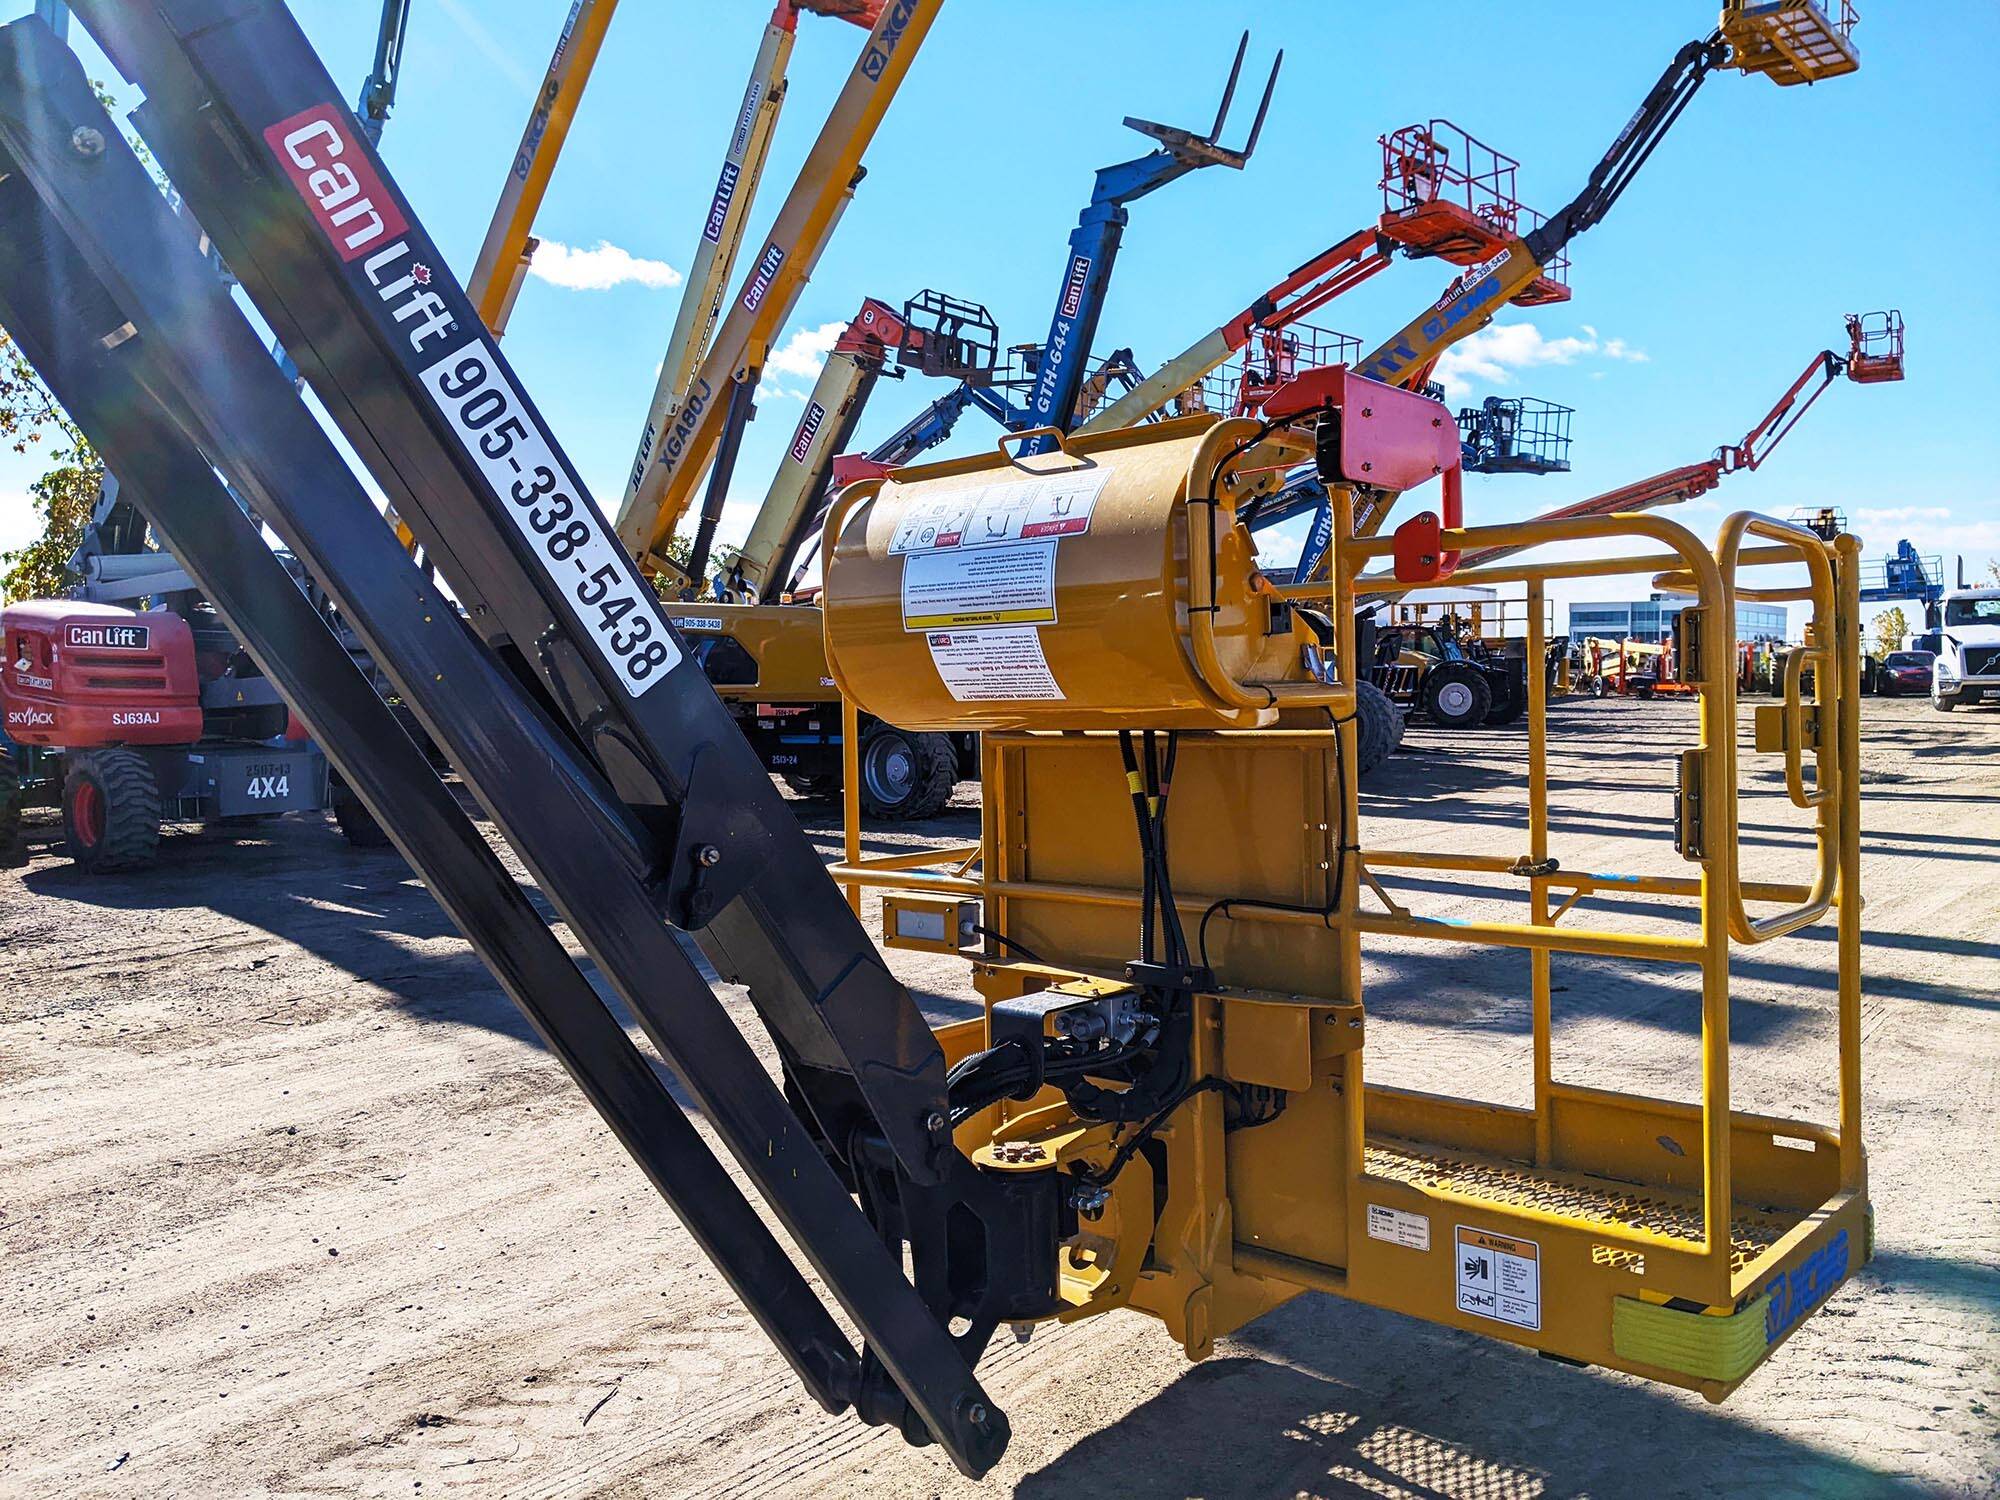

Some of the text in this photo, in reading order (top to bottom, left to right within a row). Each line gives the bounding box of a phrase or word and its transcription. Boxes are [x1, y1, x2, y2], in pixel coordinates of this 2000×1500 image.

[1463, 250, 1510, 290] 905-338-5438
[1037, 321, 1071, 414] GTH-644
[283, 118, 385, 250] Can
[437, 356, 669, 683] 905-338-5438
[658, 377, 712, 473] XGA80J
[631, 422, 657, 493] JLG LIFT
[71, 627, 103, 644] Can
[685, 619, 721, 629] 905-338-5438
[8, 706, 54, 726] SKYJACK
[112, 711, 160, 725] SJ63AJ
[247, 776, 290, 799] 4X4
[1488, 1238, 1517, 1253] WARNING
